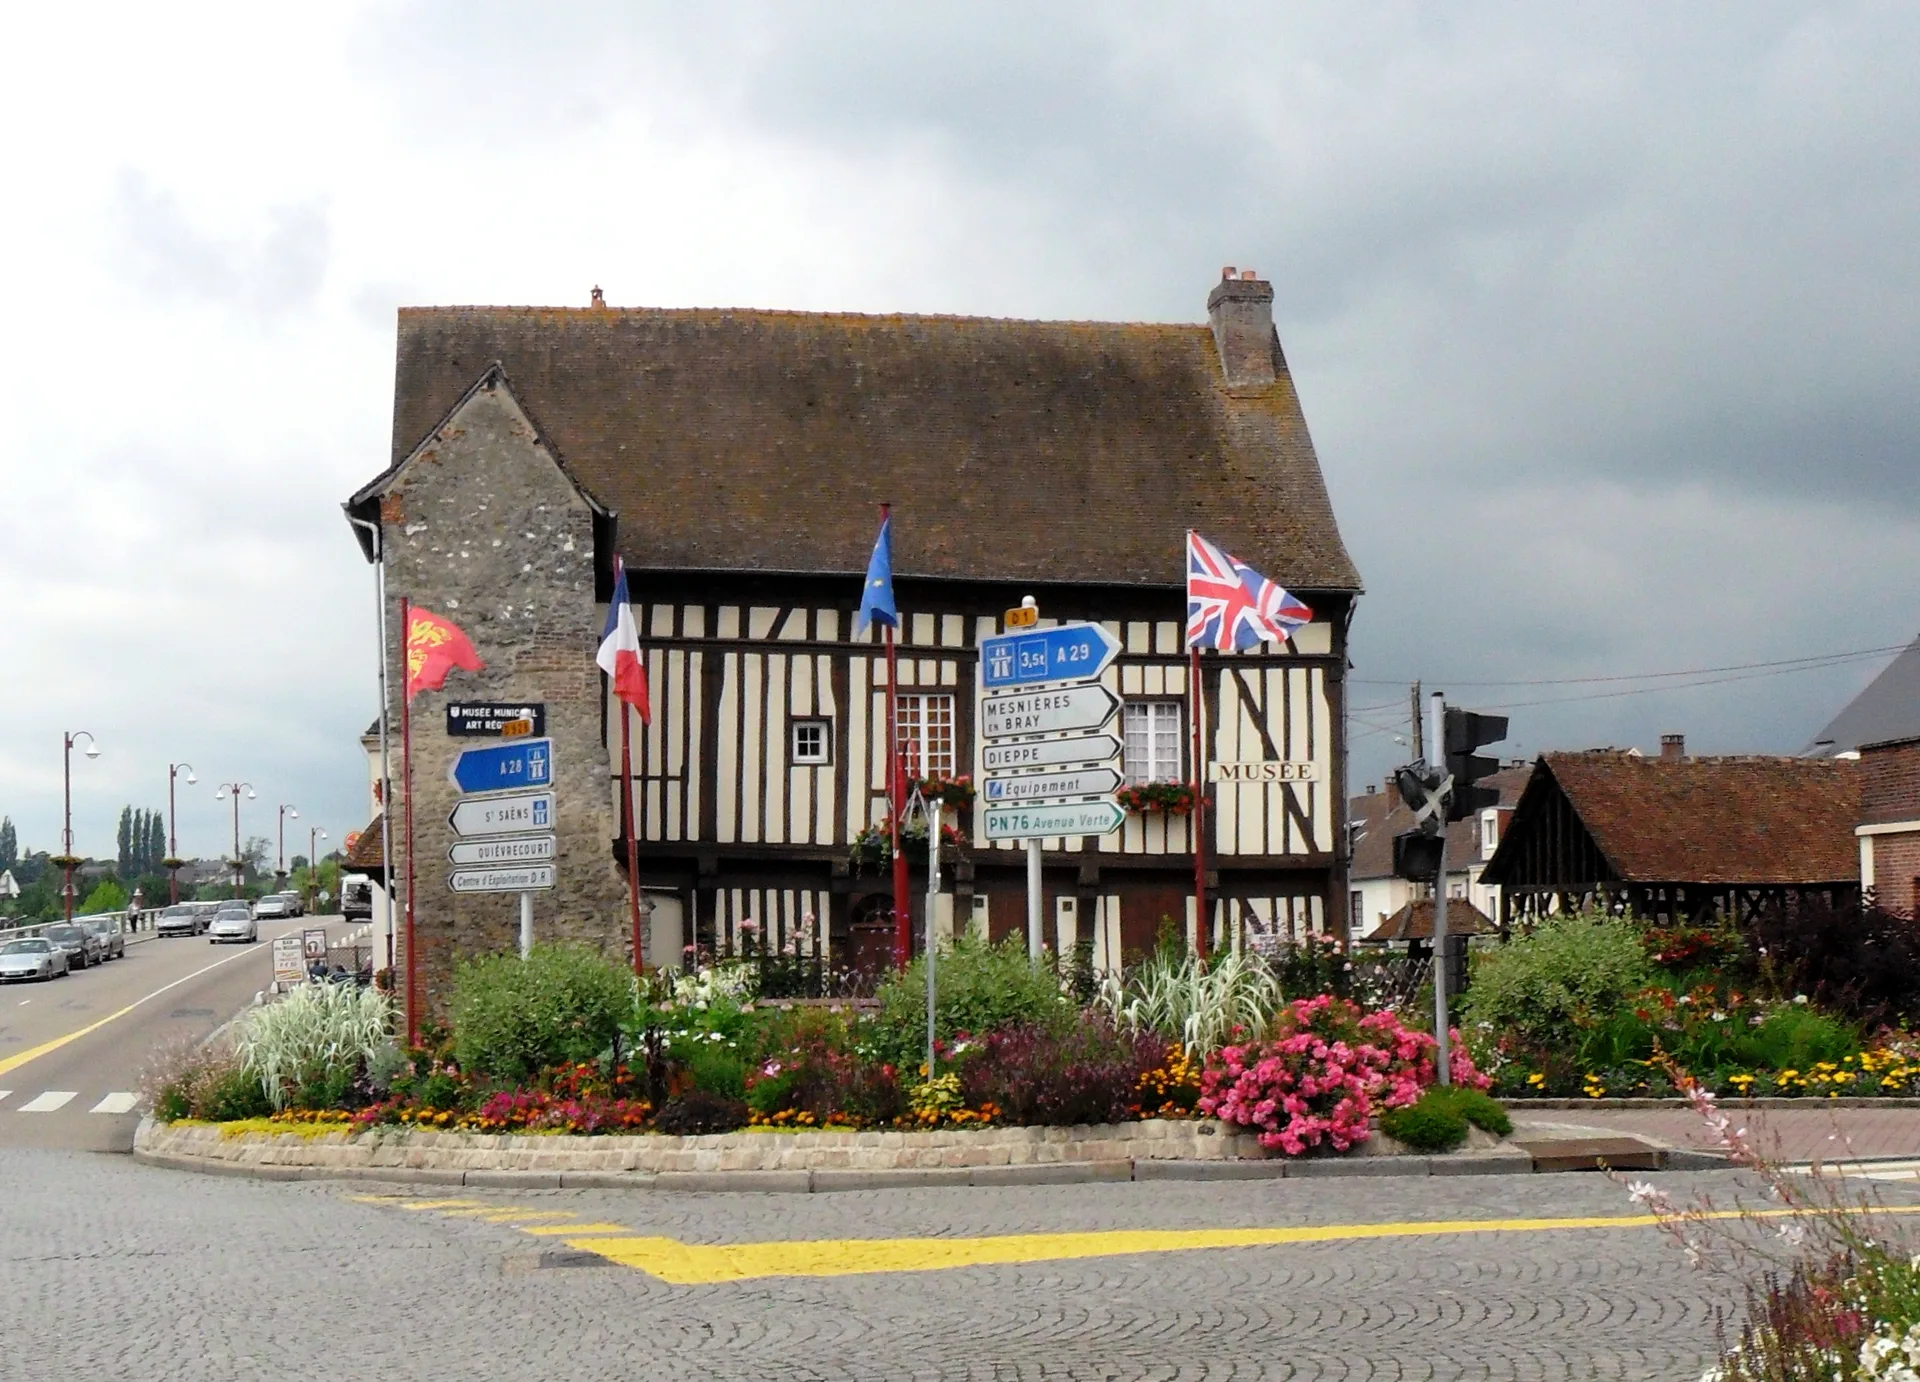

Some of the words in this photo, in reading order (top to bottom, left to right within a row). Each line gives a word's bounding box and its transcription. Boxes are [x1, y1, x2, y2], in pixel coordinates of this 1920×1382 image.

[1021, 651, 1046, 668] 3,5t
[1069, 643, 1090, 662] 29
[461, 707, 491, 717] MUSÉE
[494, 708, 538, 717] MUNICL
[466, 721, 482, 729] ART
[1005, 715, 1040, 730] BRAY
[988, 748, 1039, 764] DIEPPE
[1220, 762, 1313, 780] MUSÉE
[1005, 779, 1080, 795] Équipement
[990, 817, 1008, 831] PN
[1012, 815, 1029, 830] 76
[1033, 817, 1075, 828] Avenue
[1080, 814, 1110, 826] Verte
[478, 843, 549, 858] QUIÉVRECOURT
